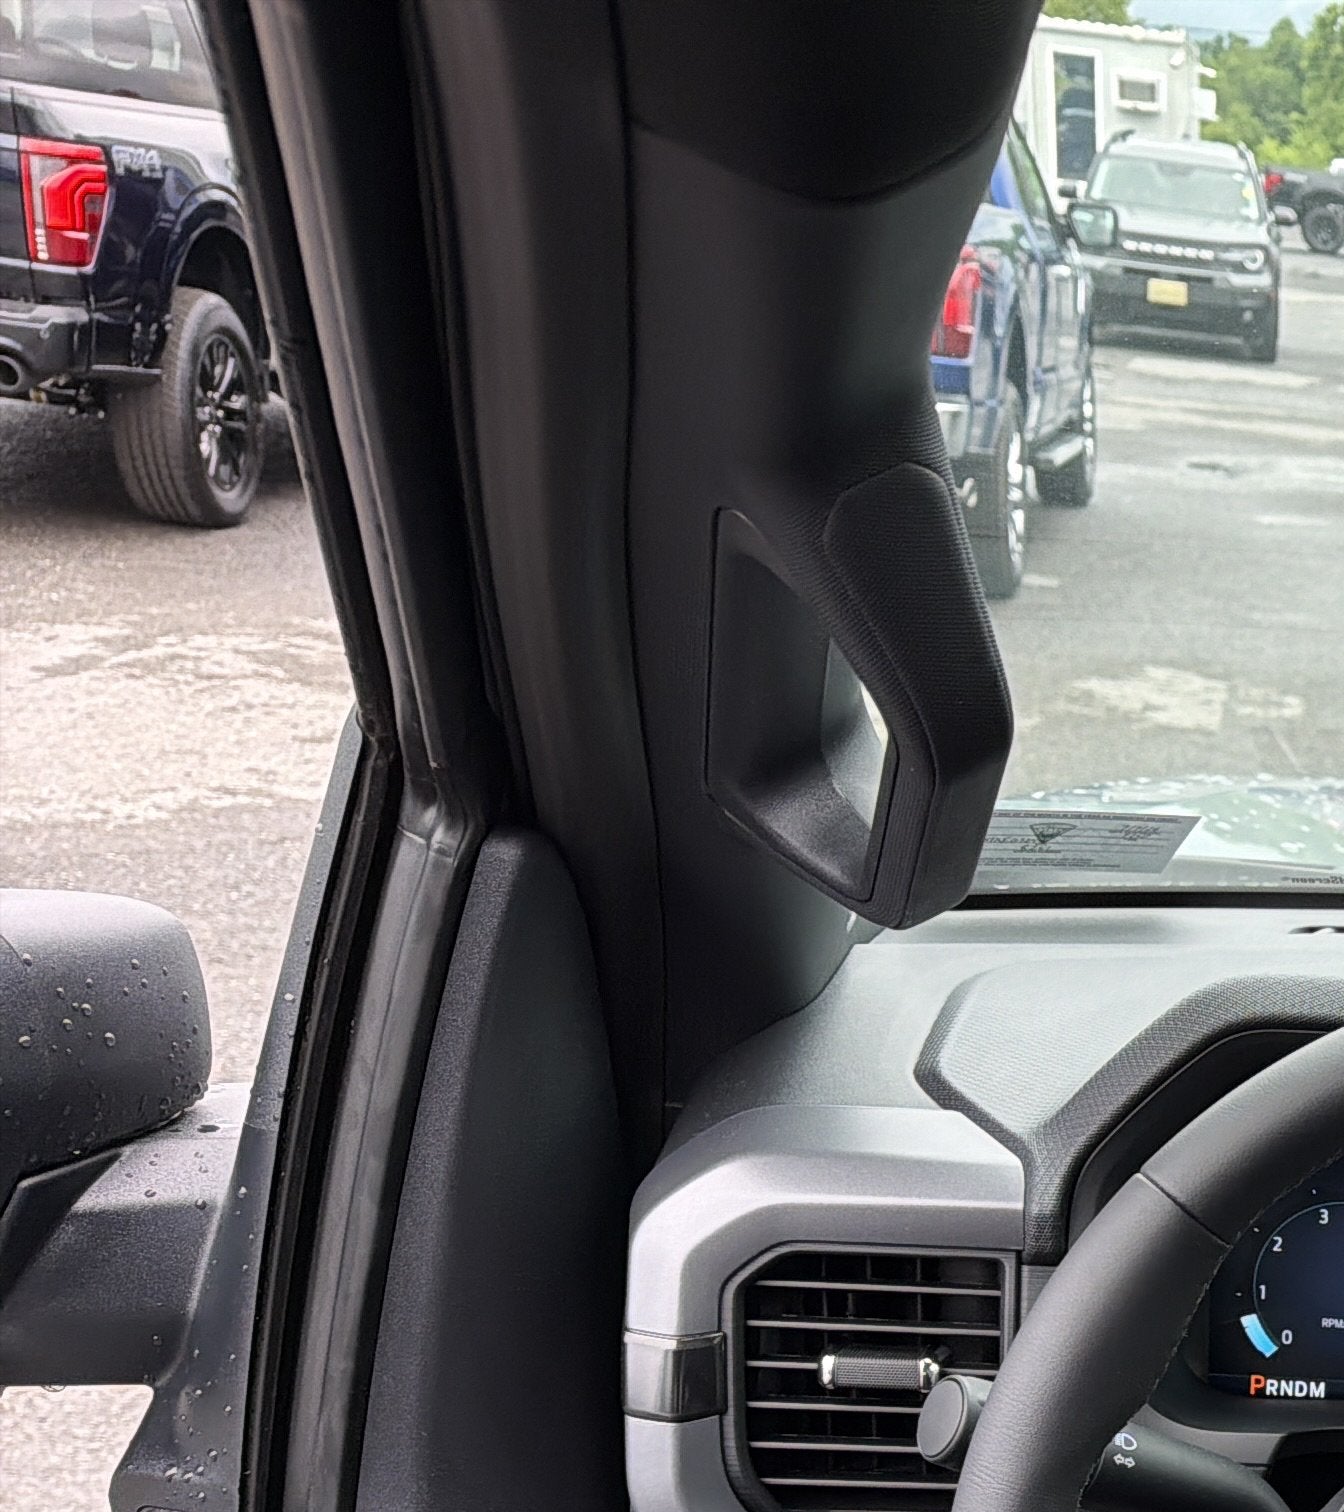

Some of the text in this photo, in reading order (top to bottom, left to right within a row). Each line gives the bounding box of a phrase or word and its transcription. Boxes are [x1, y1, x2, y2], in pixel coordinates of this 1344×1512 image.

[1319, 1209, 1329, 1225] 3
[1272, 1236, 1283, 1252] 2
[1259, 1284, 1266, 1300] 1
[1281, 1330, 1293, 1345] 0
